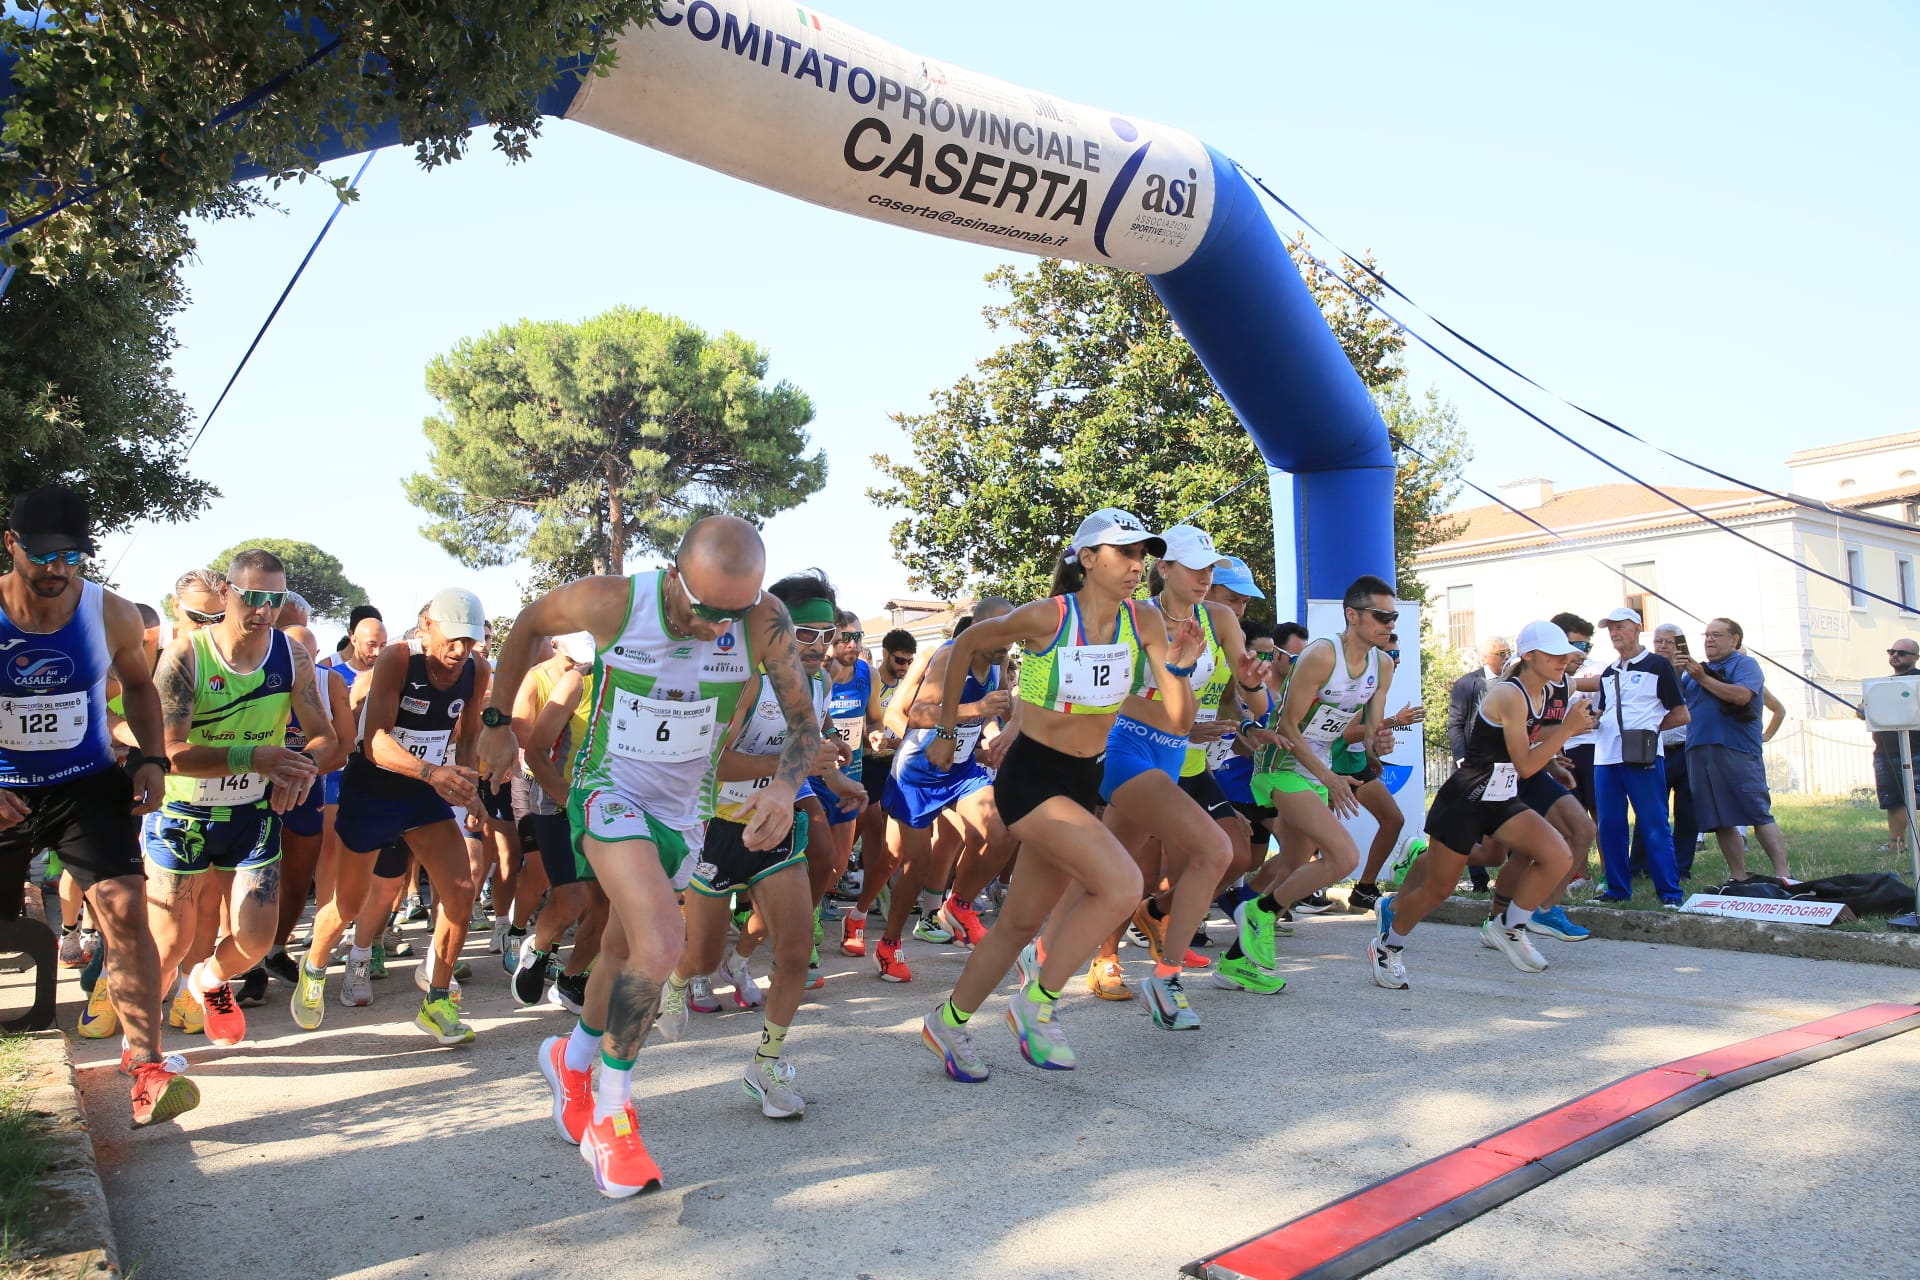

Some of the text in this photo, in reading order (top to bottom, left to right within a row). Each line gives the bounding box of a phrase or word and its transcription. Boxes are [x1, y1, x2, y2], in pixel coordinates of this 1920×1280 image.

[843, 118, 1089, 226] CASERTA
[1141, 167, 1197, 219] asi
[867, 192, 1069, 248] caserta@asinazionale.it
[1134, 214, 1191, 232] ASSOCIAZIONI
[1124, 231, 1184, 248] ITALIANE
[1092, 665, 1110, 687] 12
[19, 713, 58, 734] 122
[656, 720, 671, 742] 6
[32, 773, 44, 784] in
[220, 772, 250, 792] 146
[1504, 774, 1515, 789] 13
[1720, 900, 1833, 918] CRONOMETROGARA
